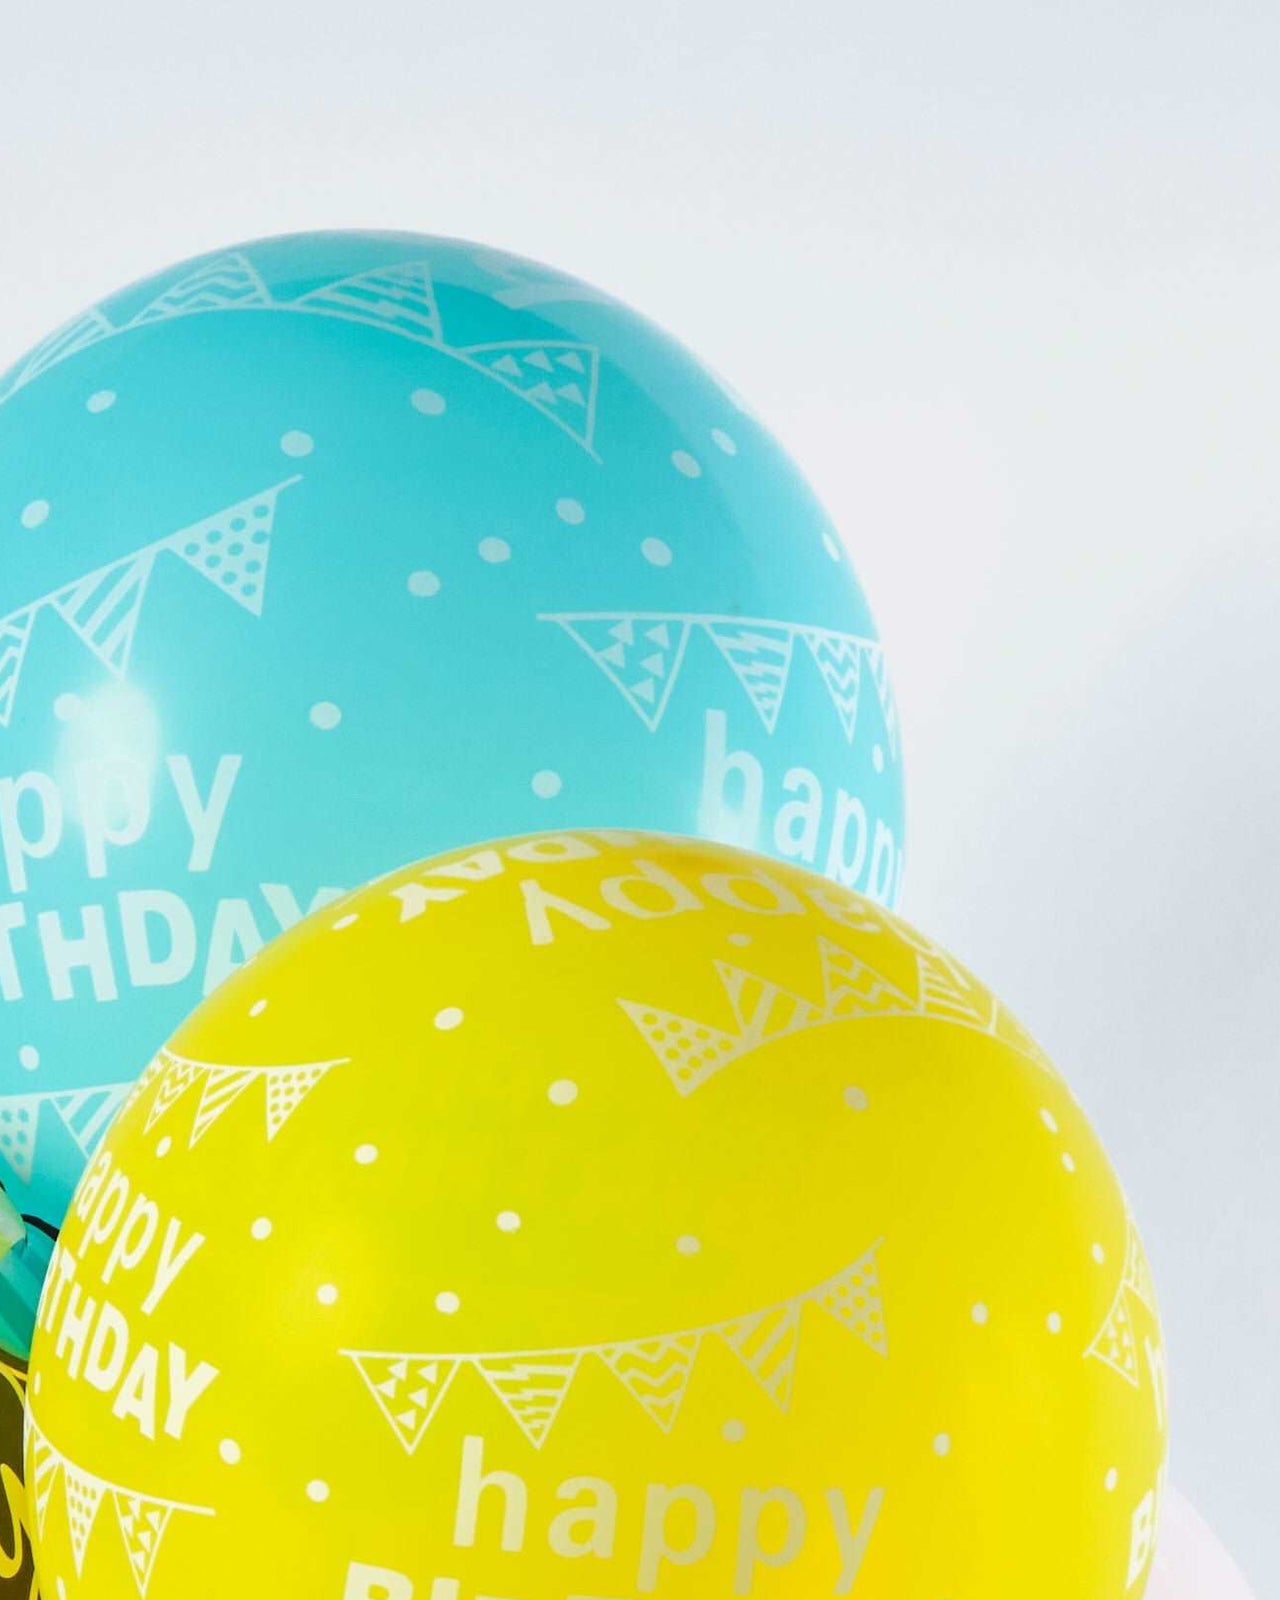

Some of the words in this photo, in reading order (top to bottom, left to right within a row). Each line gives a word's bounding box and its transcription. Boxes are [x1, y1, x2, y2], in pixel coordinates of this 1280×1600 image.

[699, 708, 903, 912] happ
[73, 1150, 205, 1317] appy
[452, 1434, 885, 1596] happy
